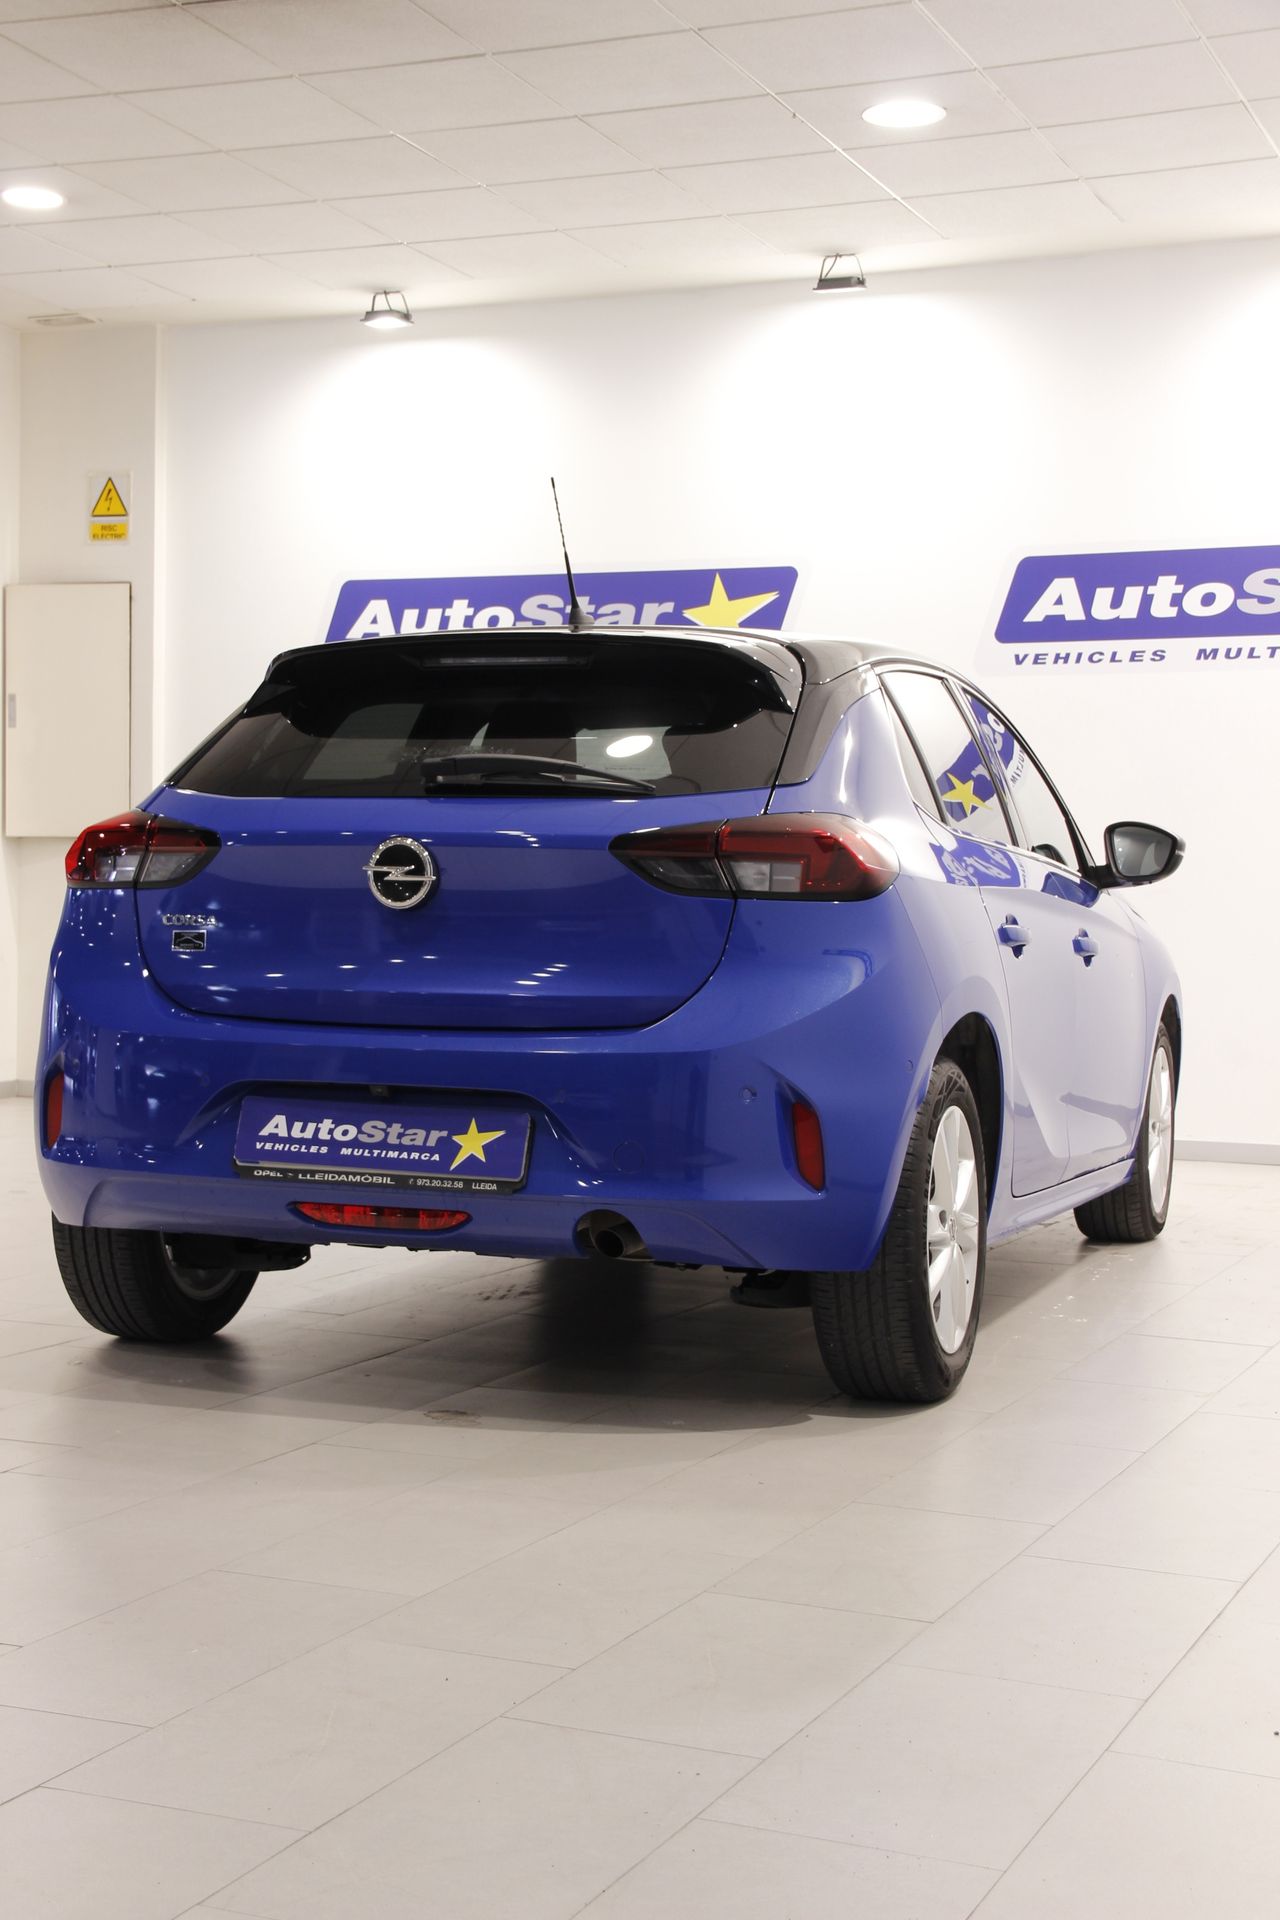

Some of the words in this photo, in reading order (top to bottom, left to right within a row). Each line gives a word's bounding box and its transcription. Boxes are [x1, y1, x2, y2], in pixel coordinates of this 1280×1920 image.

[1014, 649, 1168, 666] VEHICLES
[162, 913, 217, 926] CORSA
[258, 1114, 449, 1147] AutoStar
[255, 1141, 329, 1155] VEHICLES
[340, 1147, 441, 1163] MULTIMARCA
[253, 1169, 284, 1178] OPEL
[416, 1177, 464, 1189] 973.20.32.58
[471, 1182, 498, 1191] LLEIDA
